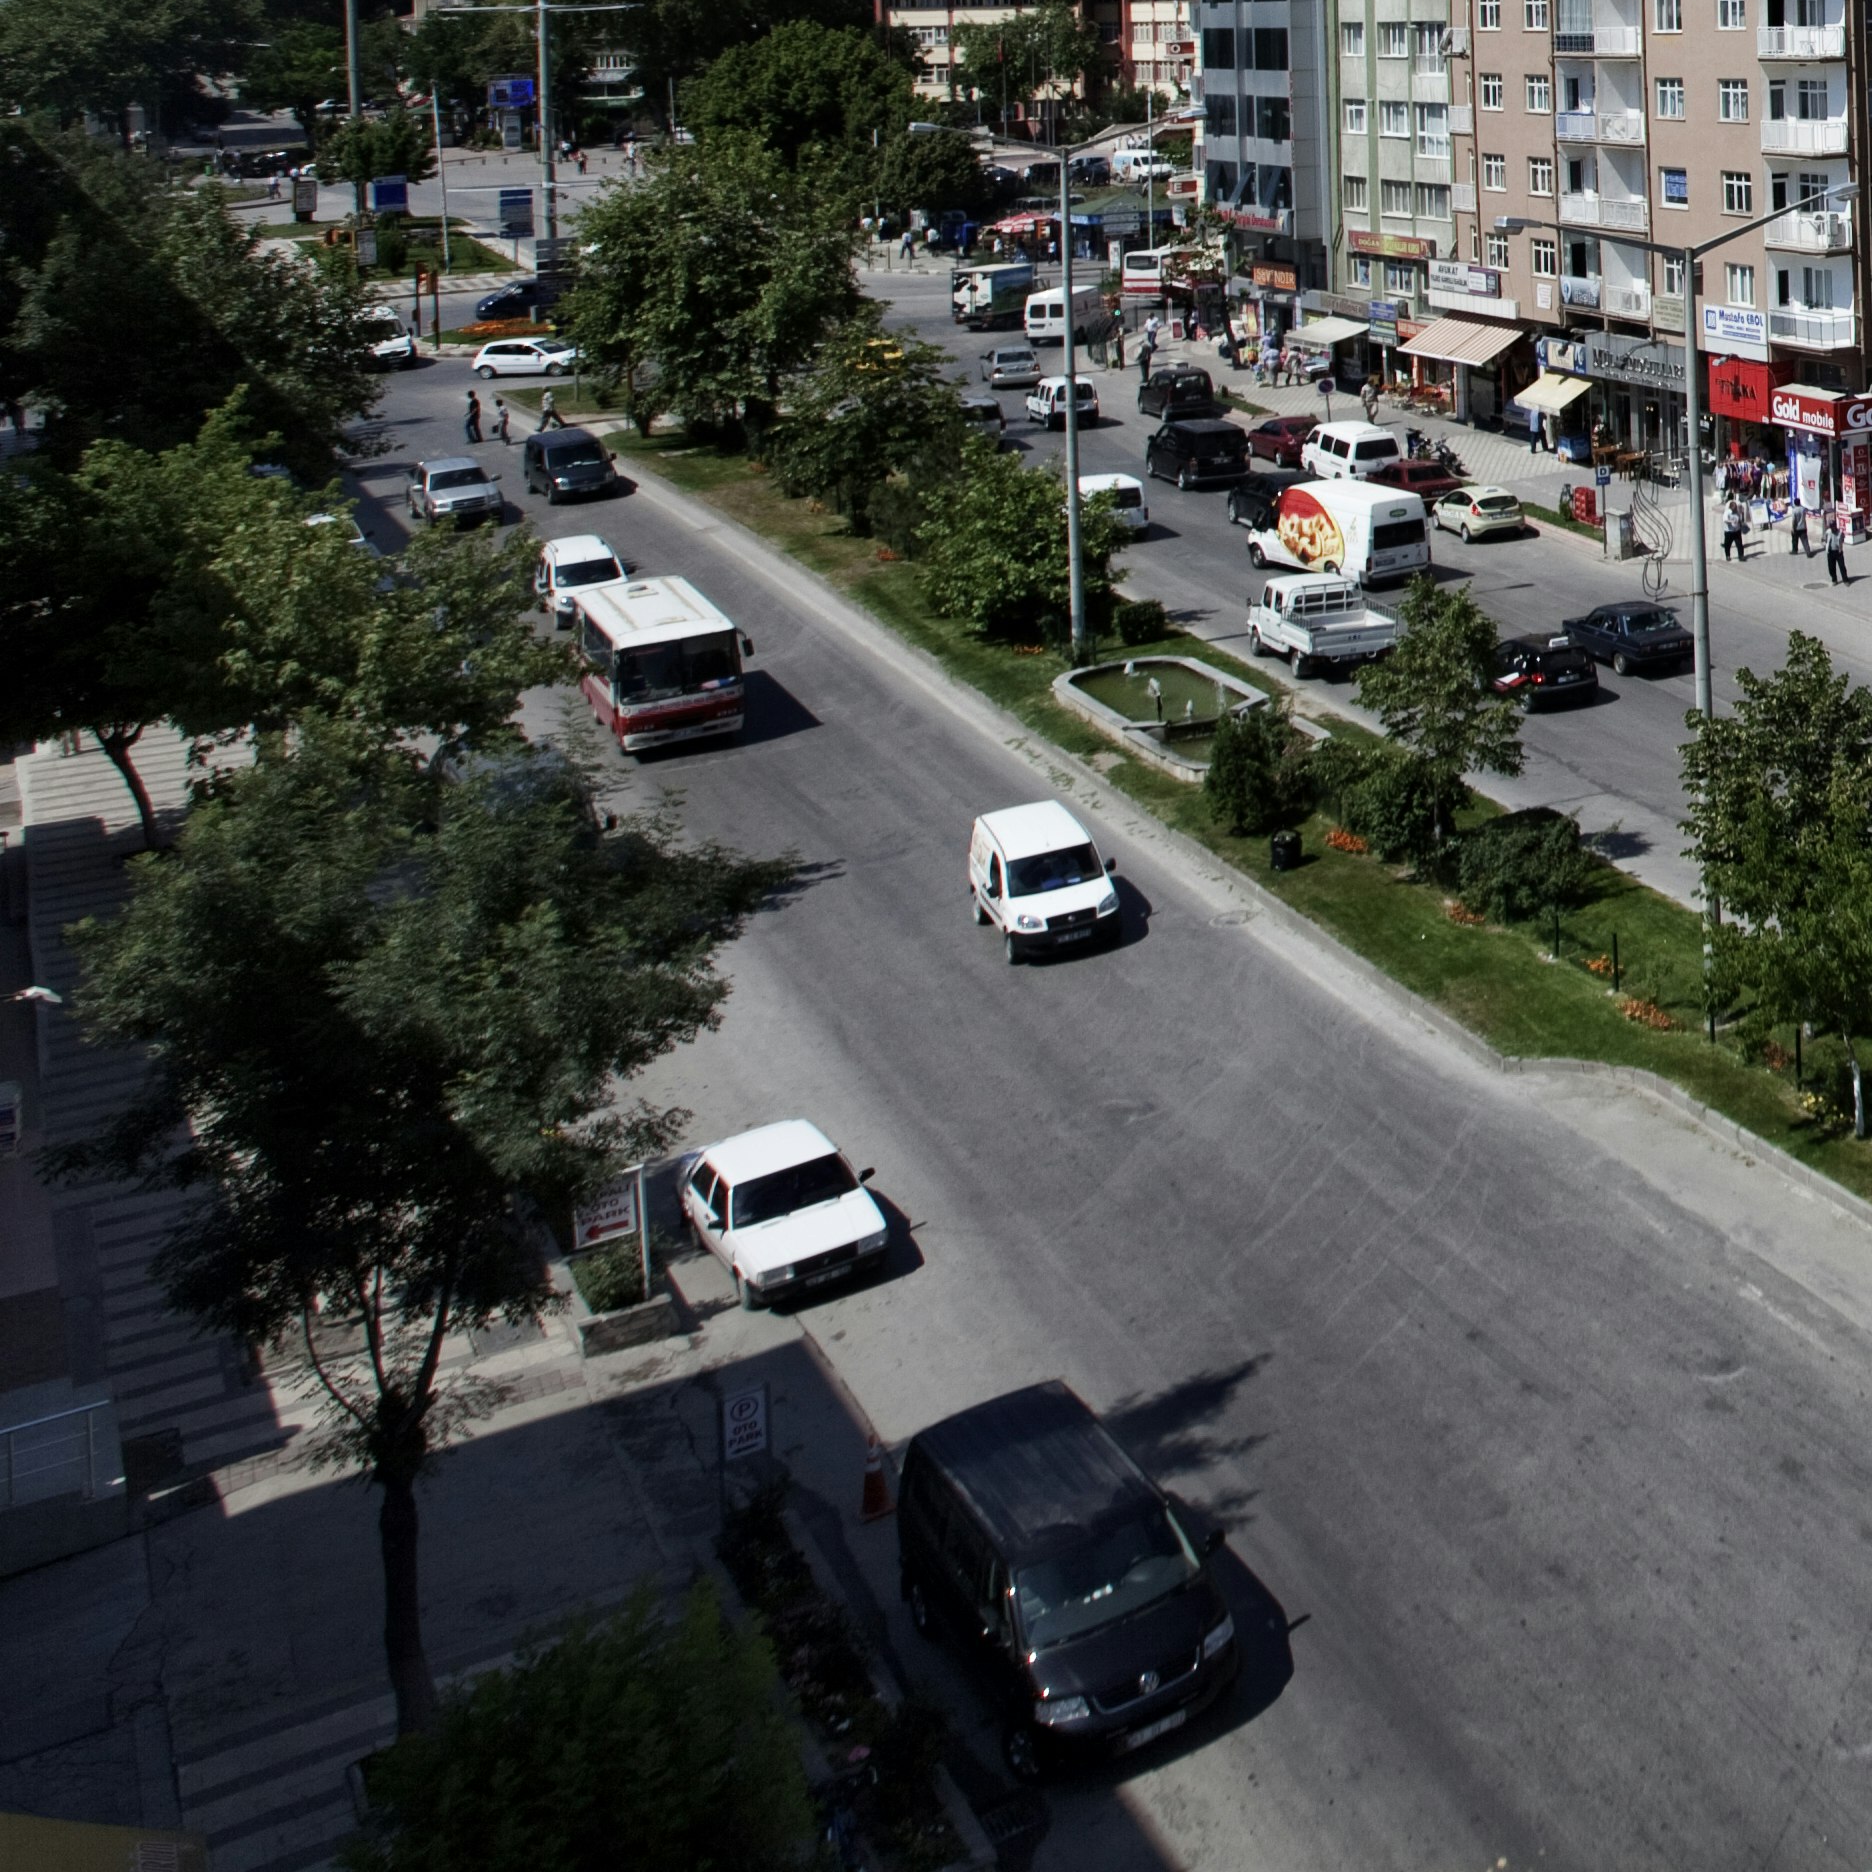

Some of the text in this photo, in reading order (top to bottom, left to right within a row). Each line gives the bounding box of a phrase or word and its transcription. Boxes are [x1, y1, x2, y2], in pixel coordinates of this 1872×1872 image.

[1772, 394, 1834, 429] Gold mobile
[590, 1198, 619, 1212] OTO
[581, 1205, 630, 1225] PARK
[733, 1420, 757, 1436] OTO
